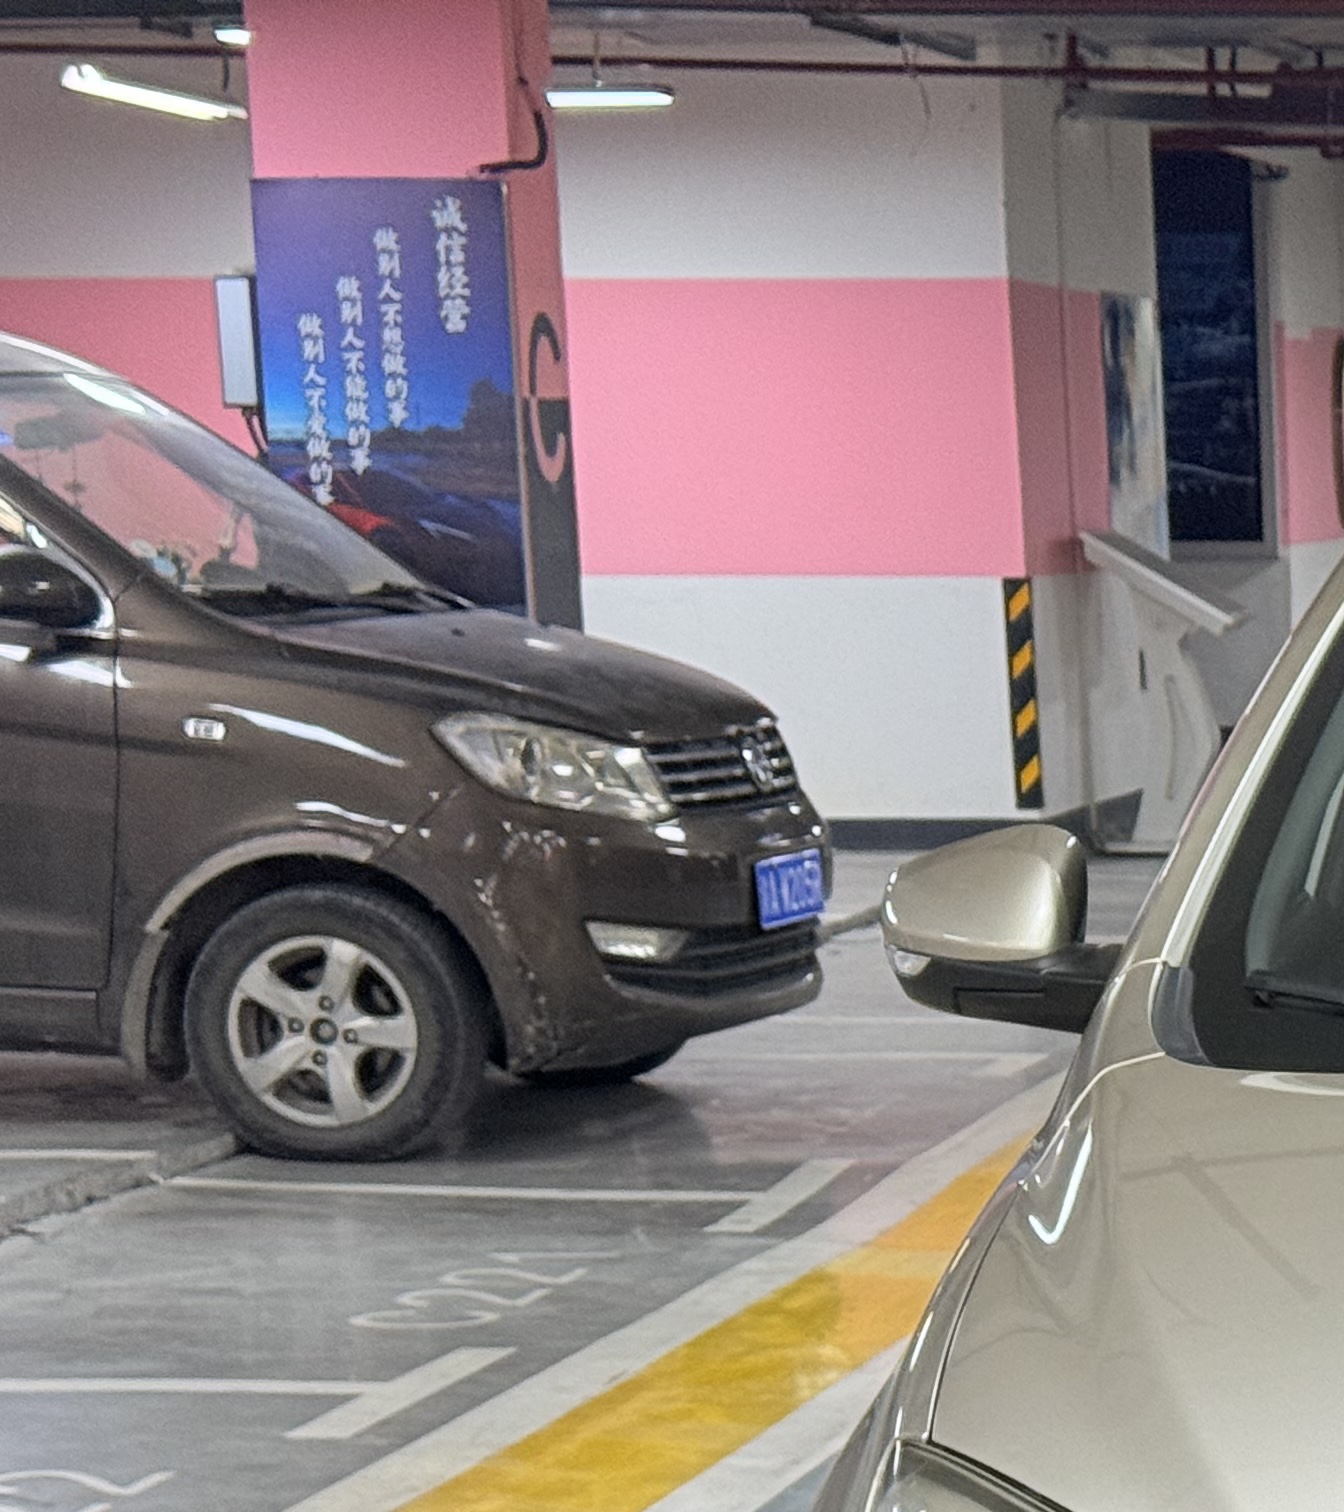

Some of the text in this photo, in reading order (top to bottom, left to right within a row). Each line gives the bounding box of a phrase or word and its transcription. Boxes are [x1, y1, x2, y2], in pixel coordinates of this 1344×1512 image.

[431, 195, 471, 335] 诚信经营
[348, 1251, 622, 1329] C221
